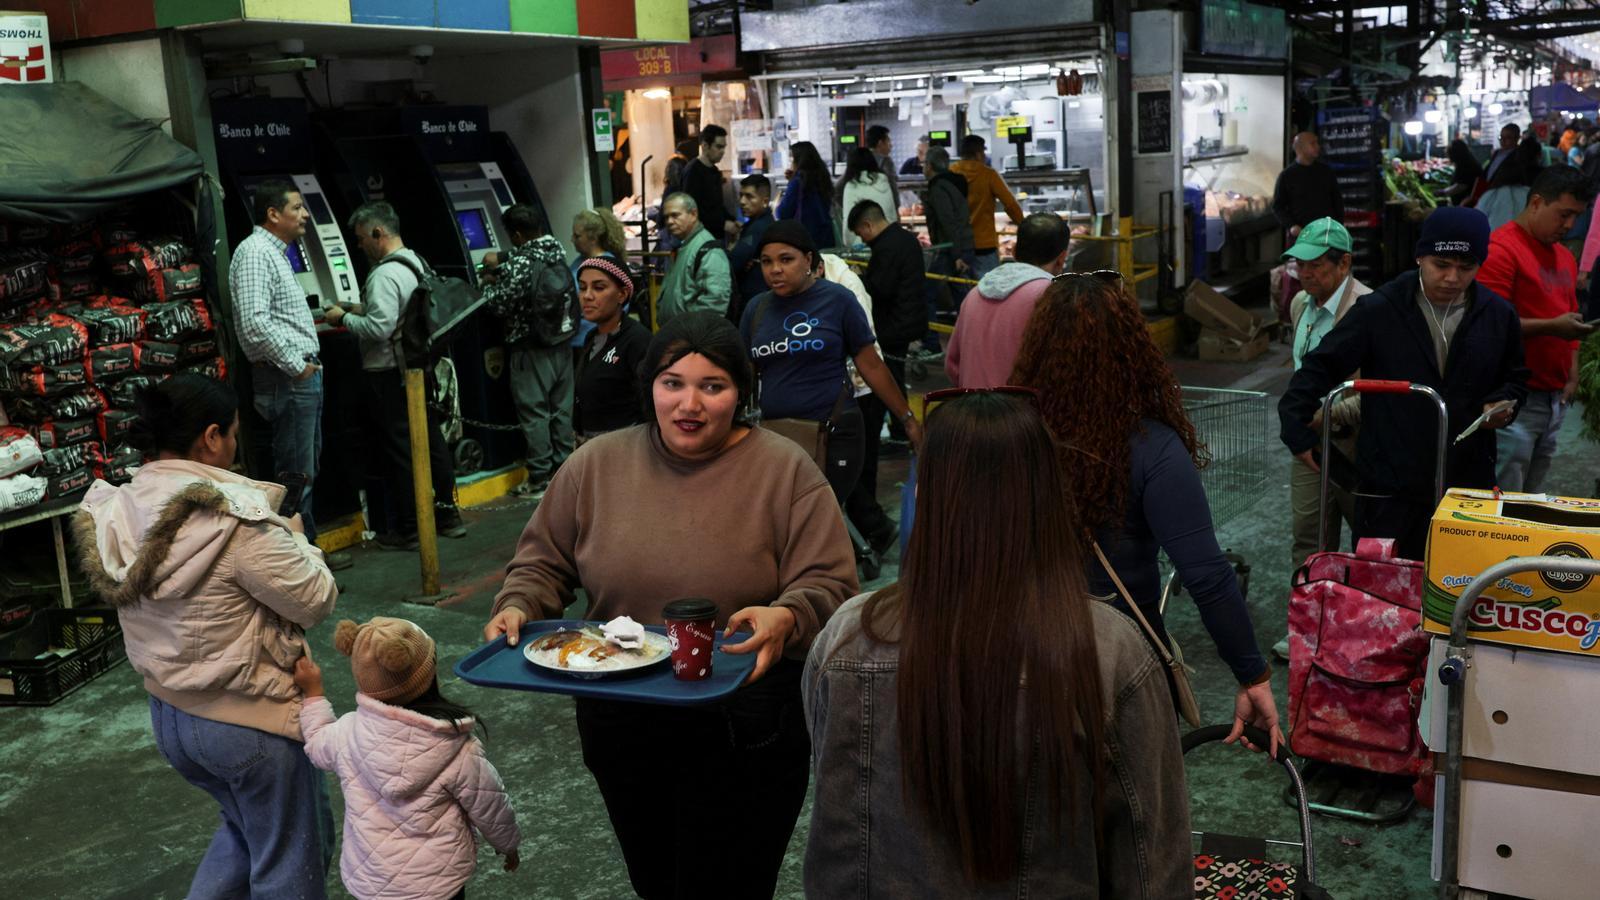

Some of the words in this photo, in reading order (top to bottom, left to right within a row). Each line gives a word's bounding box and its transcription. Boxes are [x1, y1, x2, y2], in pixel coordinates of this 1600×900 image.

[635, 47, 671, 61] LOCAL
[219, 123, 252, 138] Banco
[254, 123, 265, 137] de
[266, 122, 292, 137] Chile
[421, 120, 447, 134] Banco
[447, 121, 457, 133] de
[457, 119, 478, 132] Chile
[1439, 526, 1477, 537] PRODUCT
[1477, 530, 1489, 538] OF
[1490, 531, 1530, 543] ECUADOR
[1497, 577, 1535, 597] Fresh
